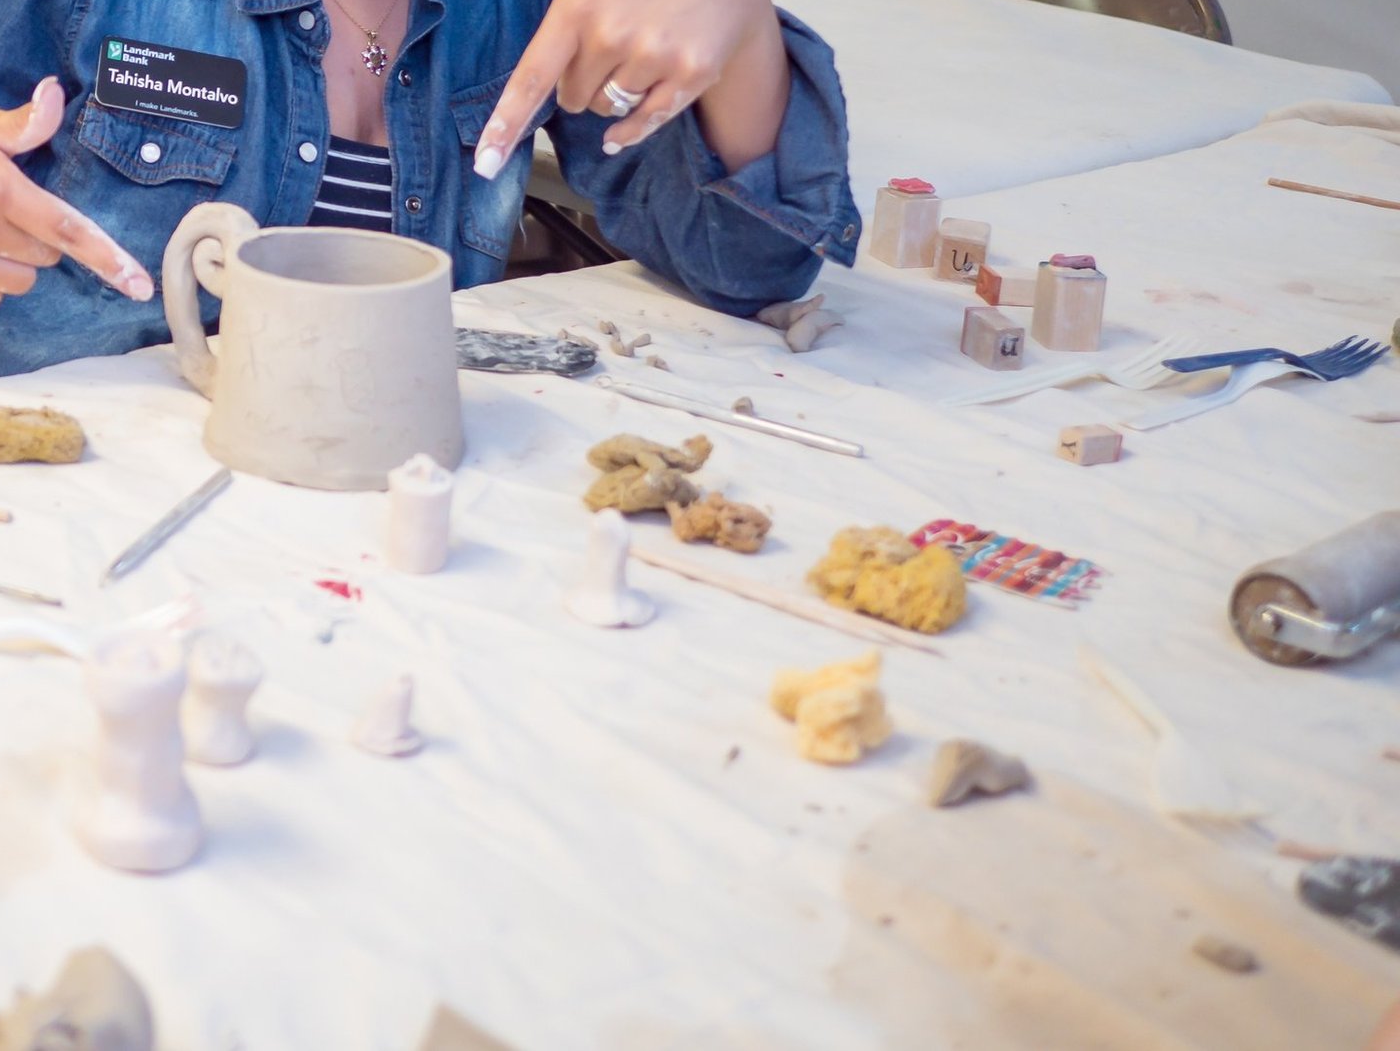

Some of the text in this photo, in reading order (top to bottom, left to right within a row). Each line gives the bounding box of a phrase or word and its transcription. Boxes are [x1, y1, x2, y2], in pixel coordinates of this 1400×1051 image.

[122, 54, 148, 66] Bank
[123, 44, 175, 61] Landmark
[108, 67, 239, 105] Tahisha Montalvo
[140, 101, 158, 111] make
[160, 105, 199, 118] Landmarks.
